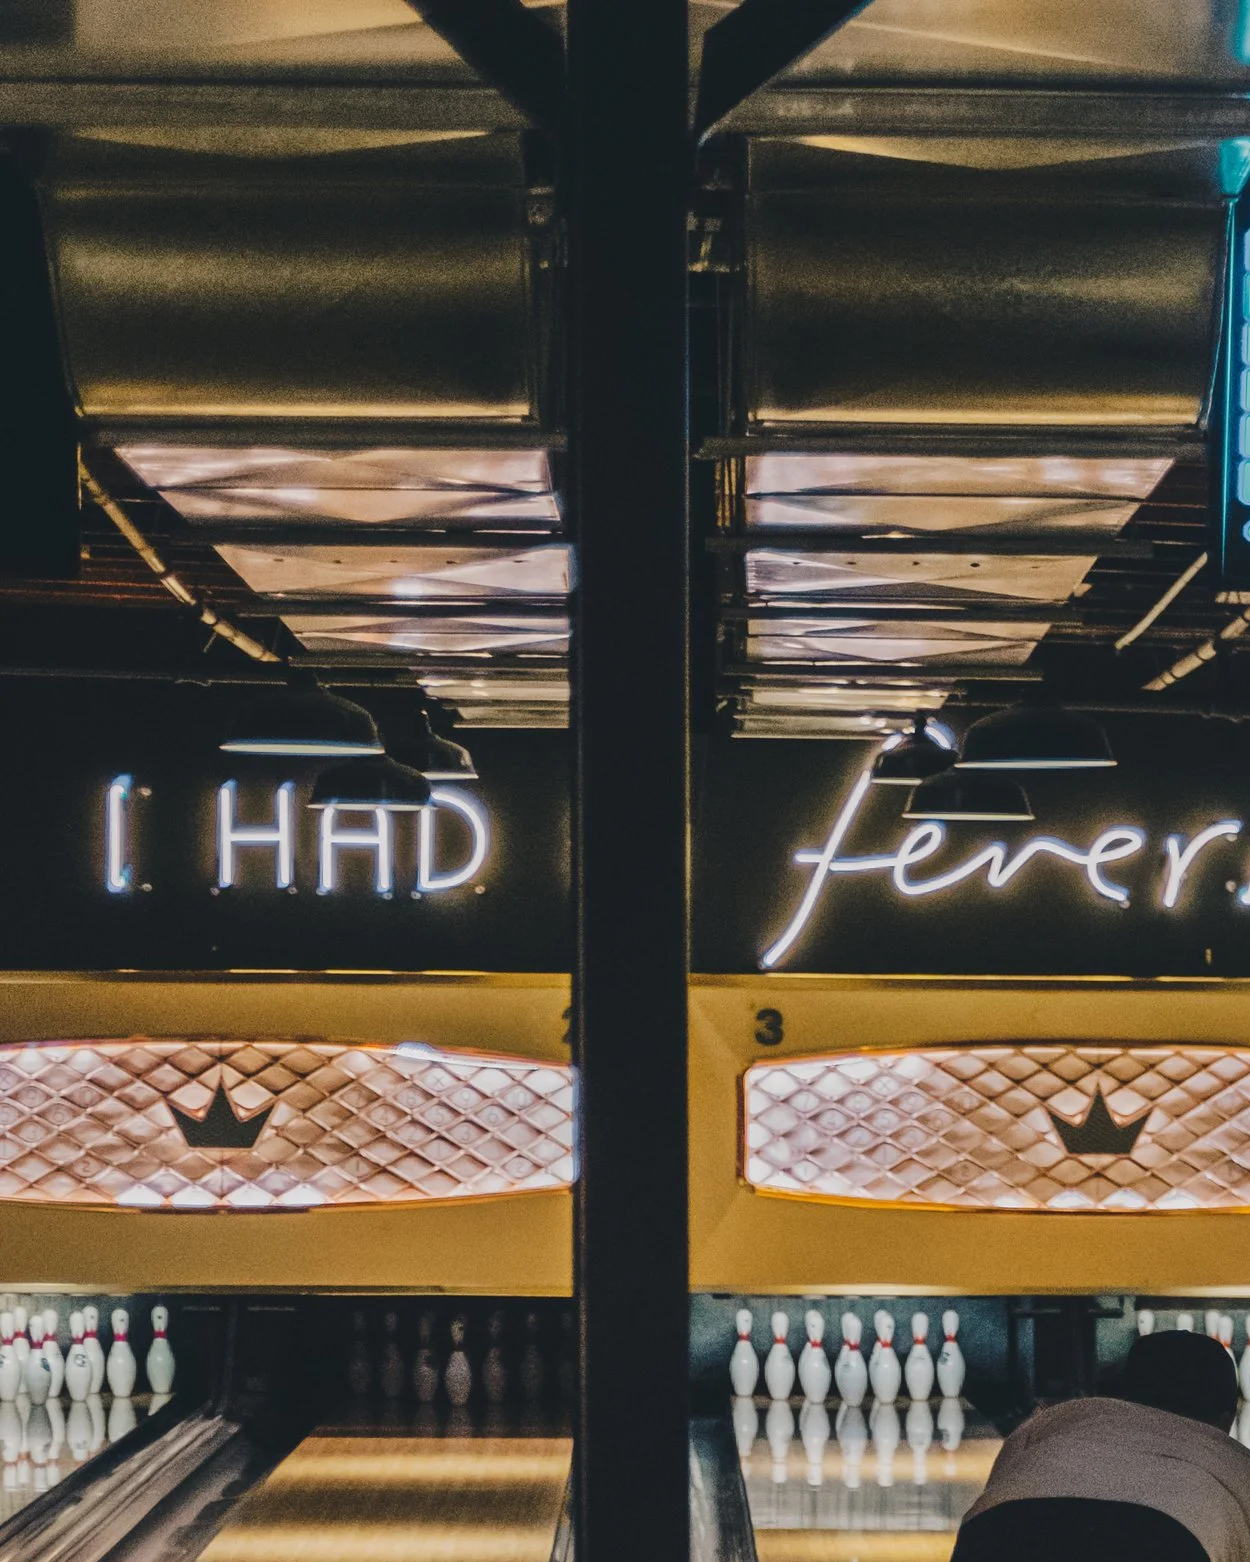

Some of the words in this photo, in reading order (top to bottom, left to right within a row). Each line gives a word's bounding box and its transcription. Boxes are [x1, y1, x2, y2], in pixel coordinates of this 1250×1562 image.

[105, 774, 133, 893] I
[216, 780, 490, 893] HAD
[755, 1008, 784, 1046] 3
